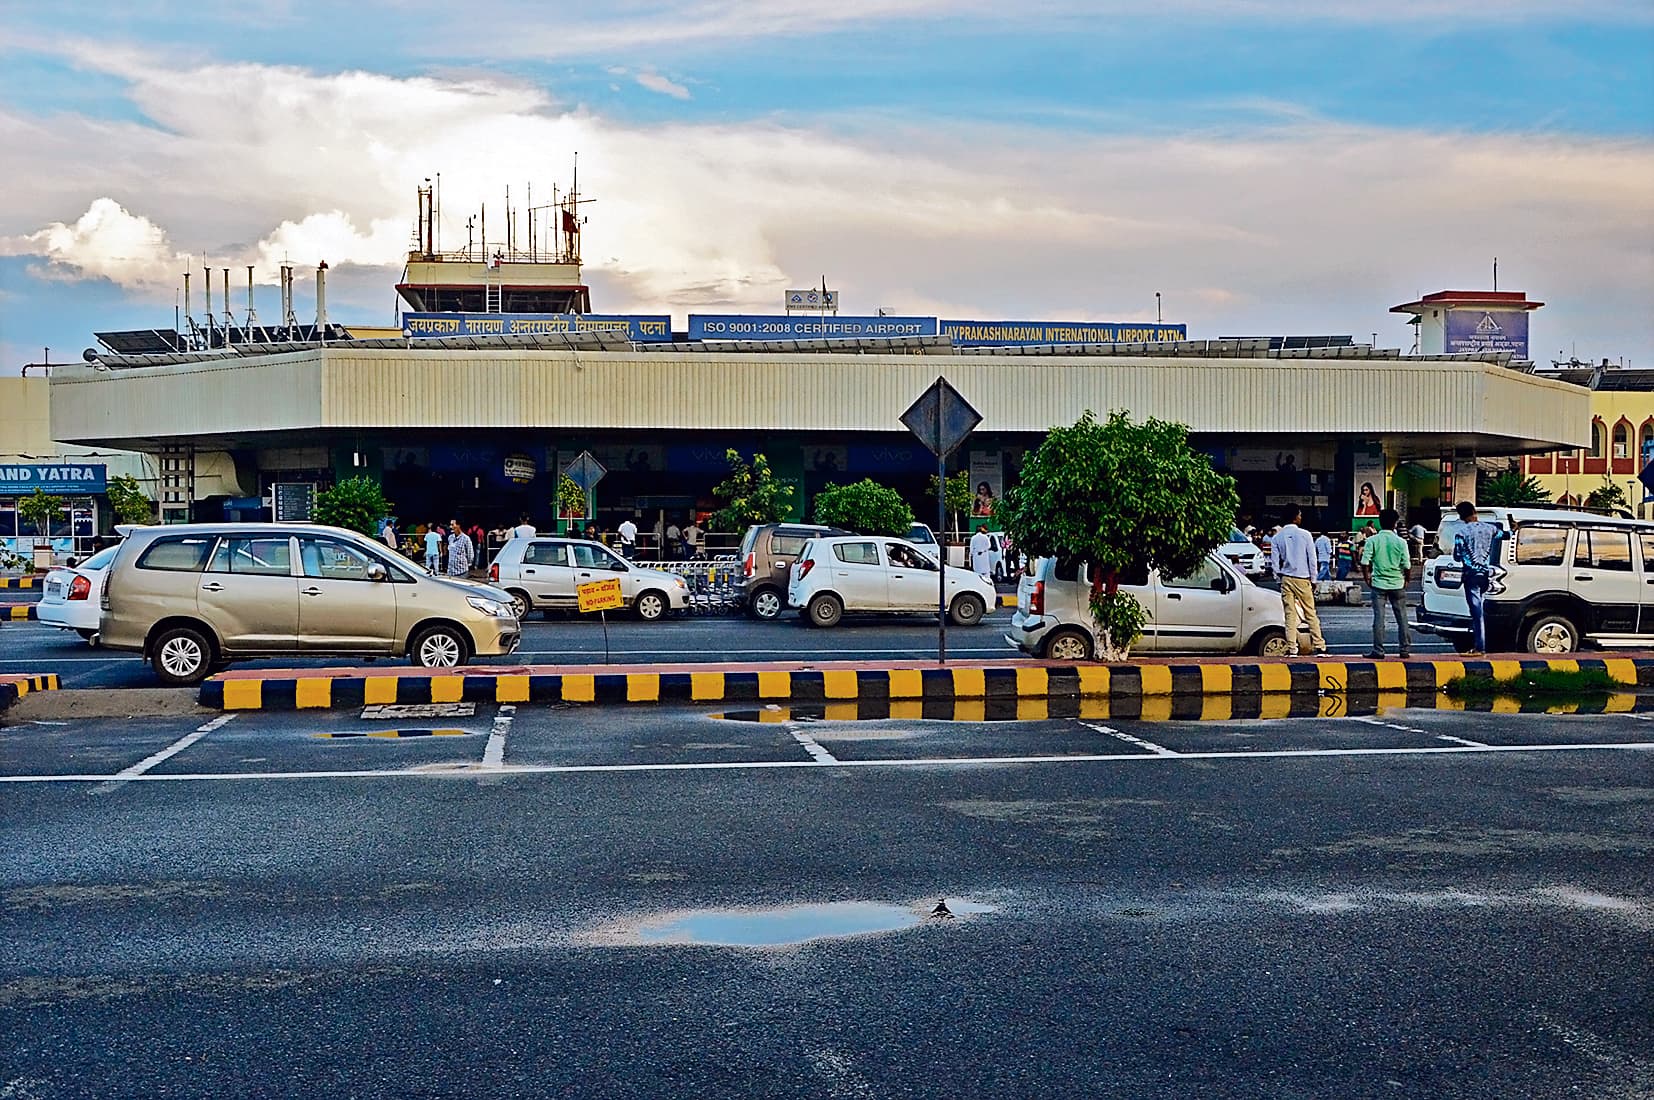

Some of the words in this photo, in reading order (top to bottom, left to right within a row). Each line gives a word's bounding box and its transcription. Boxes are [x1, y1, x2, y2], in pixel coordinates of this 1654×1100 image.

[407, 318, 460, 334] जयप्रकाश
[465, 319, 504, 334] नारायण
[639, 321, 666, 335] पटना
[703, 322, 726, 333] ISO
[729, 322, 791, 333] 9001:2008
[794, 323, 862, 334] CERTIFIED
[865, 324, 922, 334] AIRPORT
[1045, 327, 1115, 342] INTERNATIONAL
[36, 467, 95, 481] YATRA
